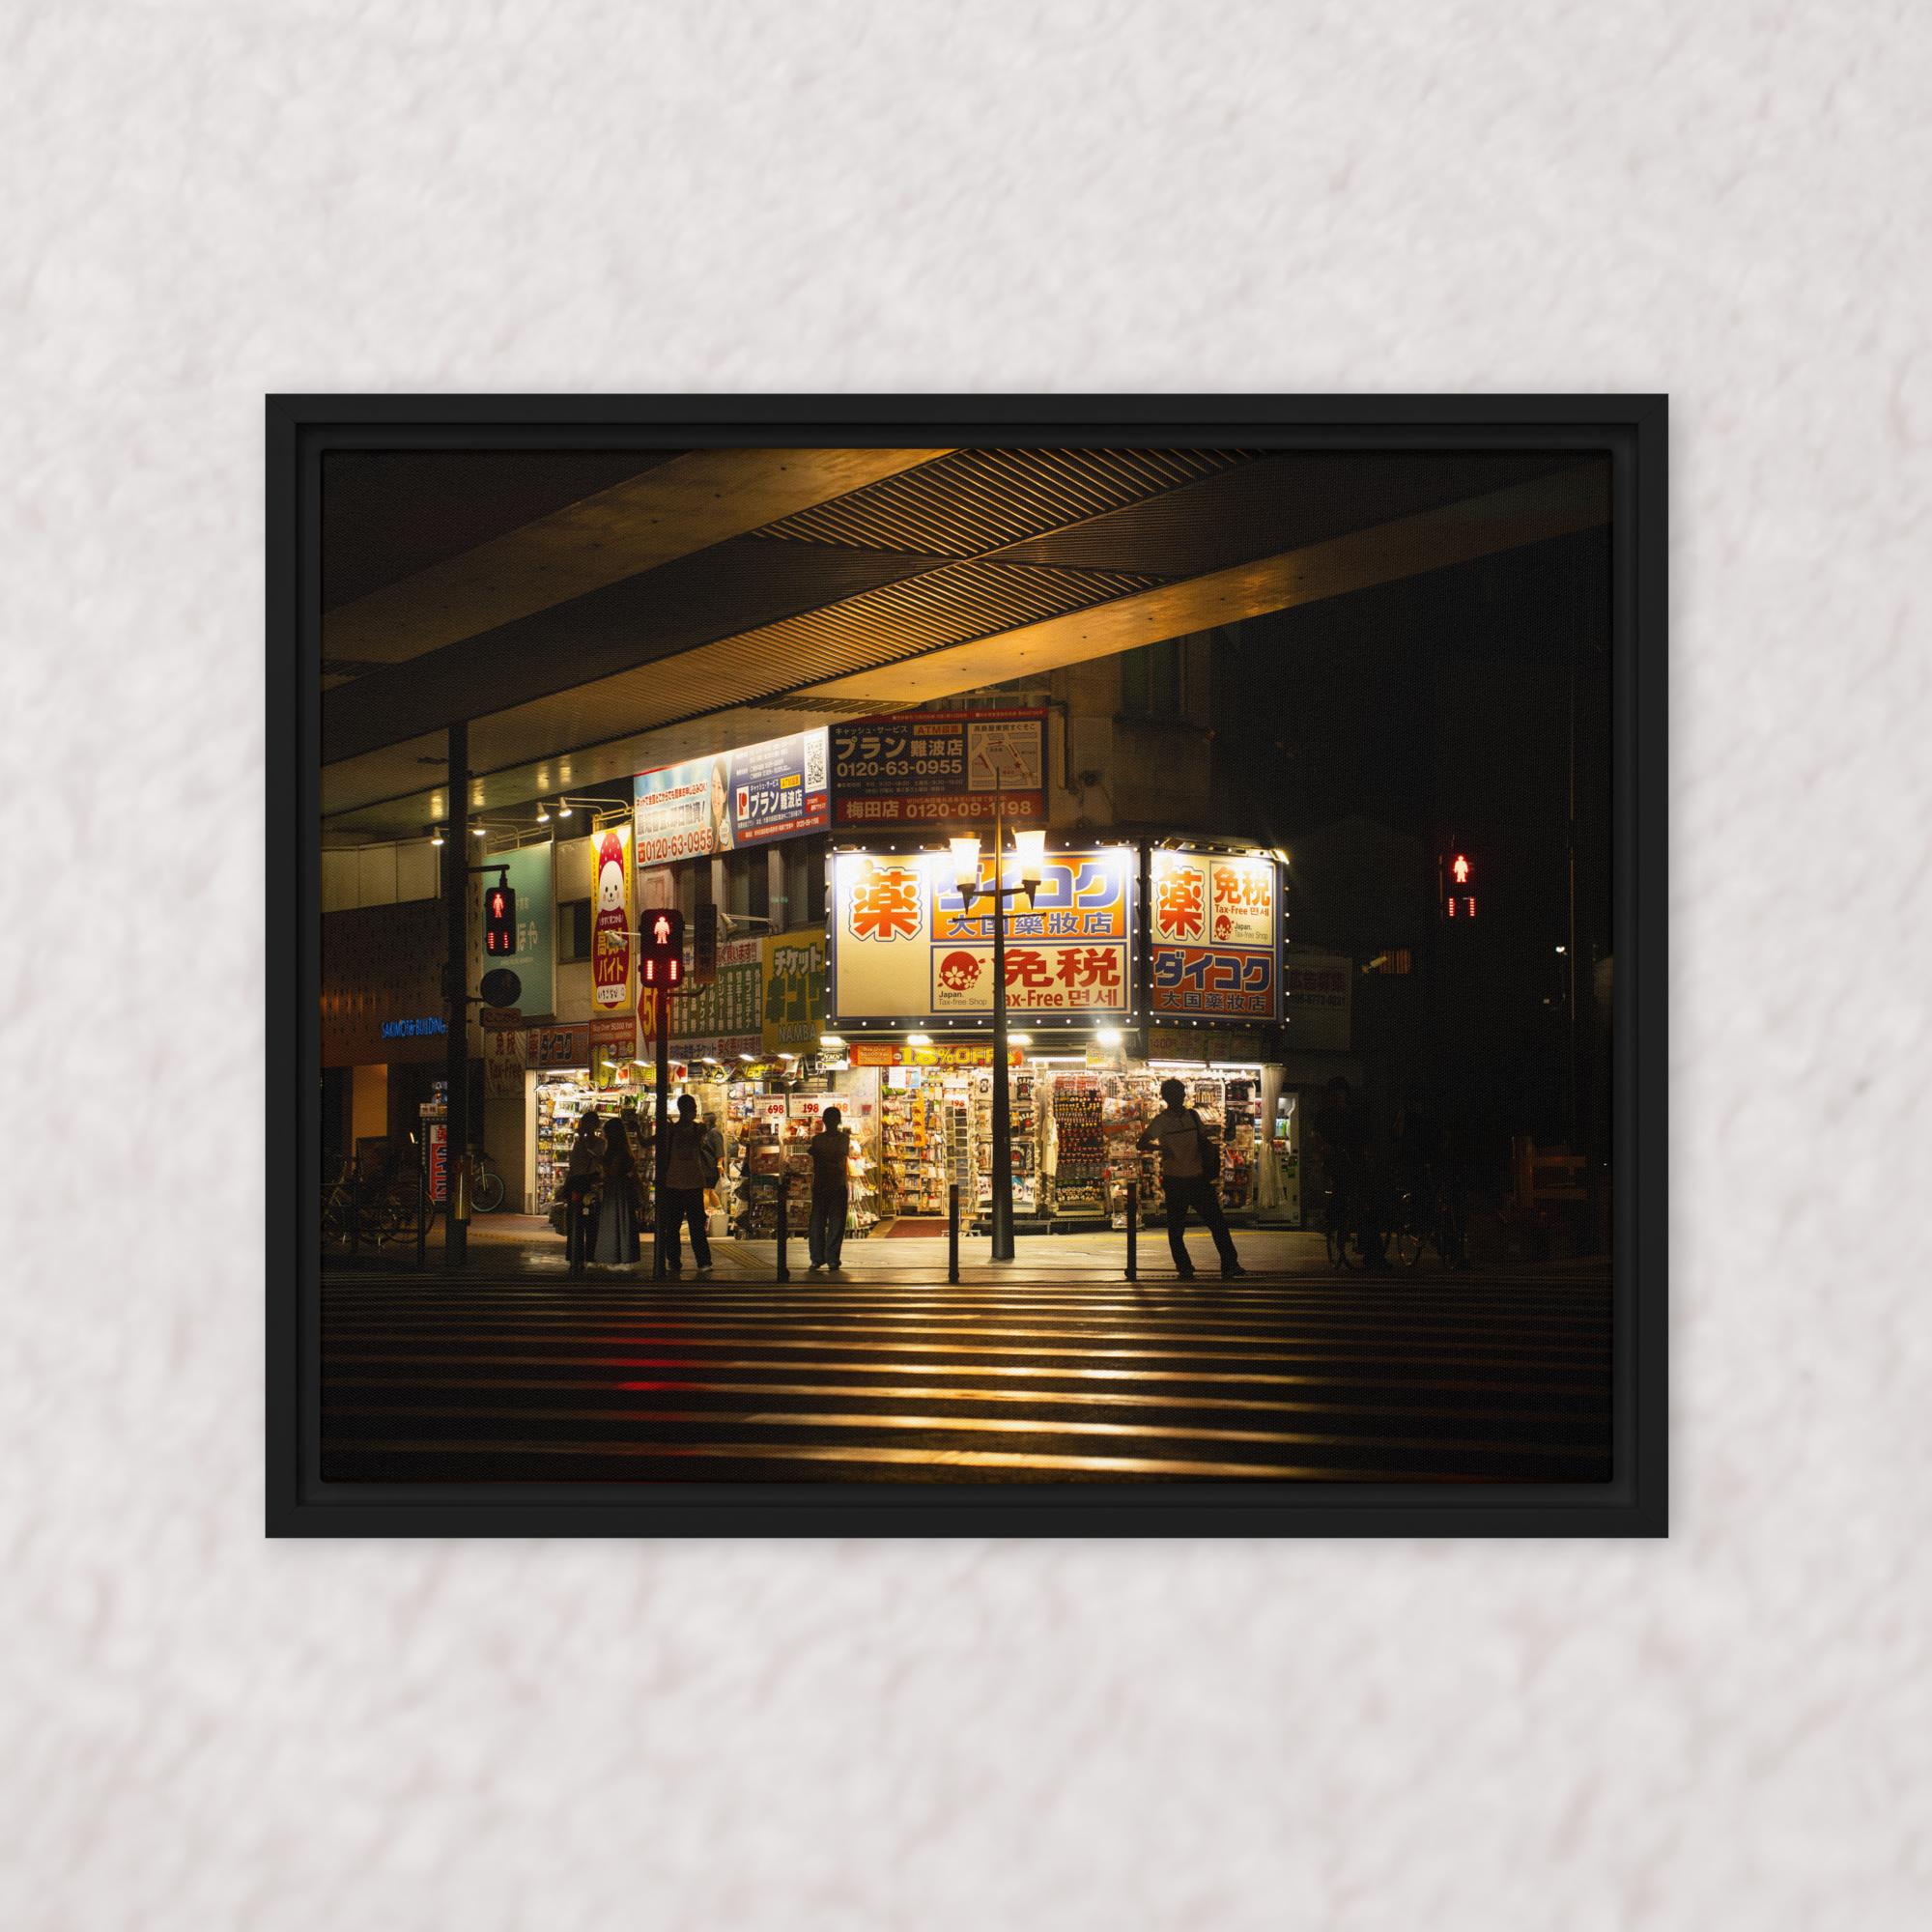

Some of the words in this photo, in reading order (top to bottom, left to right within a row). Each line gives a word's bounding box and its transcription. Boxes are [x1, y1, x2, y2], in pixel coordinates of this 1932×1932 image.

[835, 736, 906, 760] プラン
[910, 739, 963, 758] 難波店
[751, 791, 779, 818] プラン
[846, 801, 899, 818] 梅田店
[1213, 867, 1270, 907] 免税
[853, 870, 920, 939] 薬
[1159, 869, 1203, 937] 薬
[1214, 904, 1248, 916] Tax-Free
[599, 956, 624, 982] バイト
[775, 946, 821, 977] チケット
[1004, 948, 1122, 988] 免税
[1154, 951, 1271, 993] ダイコク
[969, 998, 987, 1007] Shop
[1006, 988, 1063, 1008] ax-Free
[1068, 989, 1118, 1008] 면세
[767, 1104, 784, 1114] 698
[802, 1103, 819, 1114] 198
